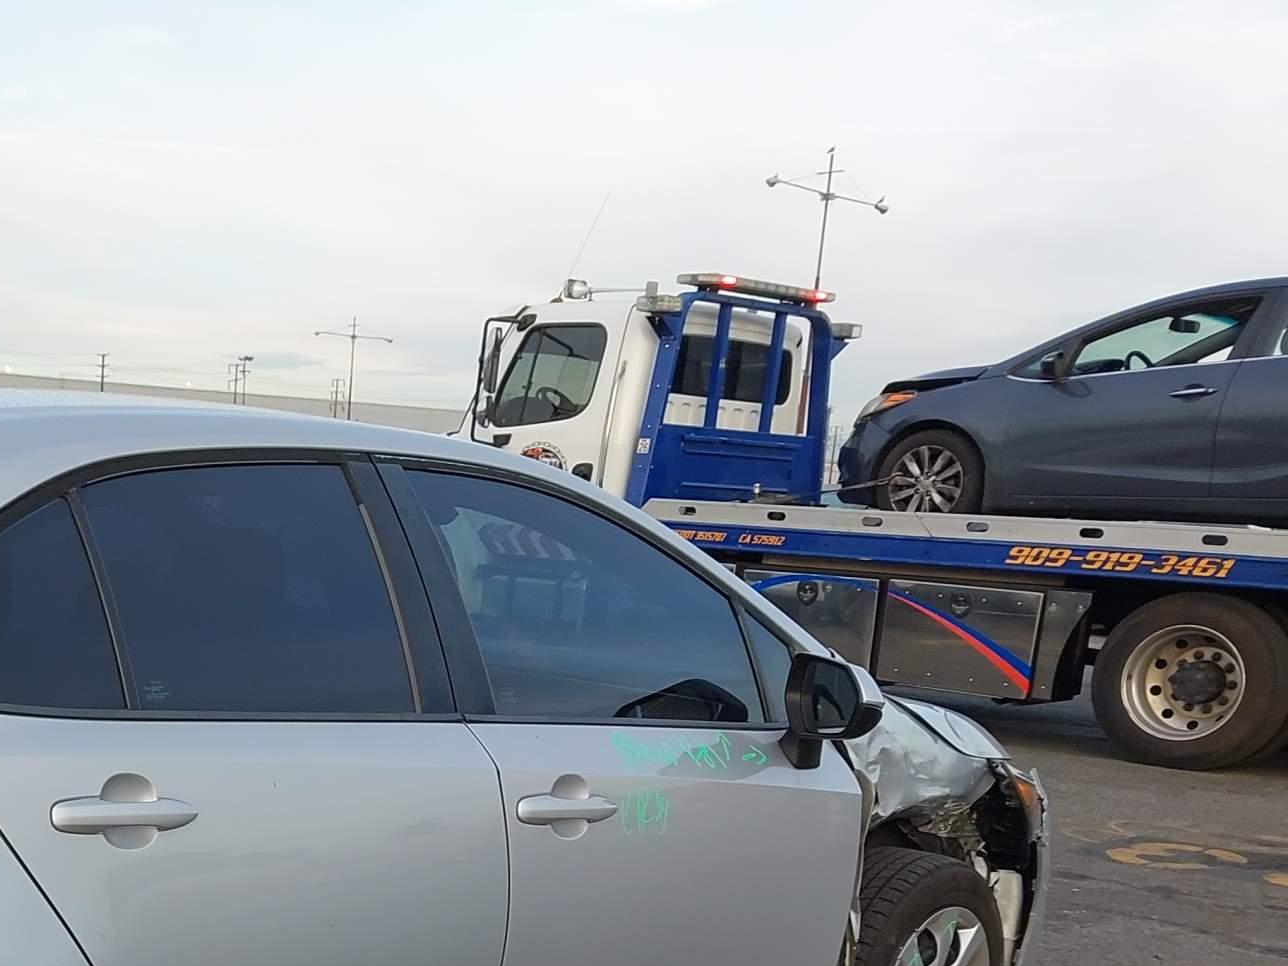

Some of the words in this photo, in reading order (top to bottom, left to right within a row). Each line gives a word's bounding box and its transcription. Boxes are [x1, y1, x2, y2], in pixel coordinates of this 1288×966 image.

[738, 533, 751, 544] CA
[752, 535, 786, 546] 575912
[1005, 546, 1236, 578] 909-919-3461
